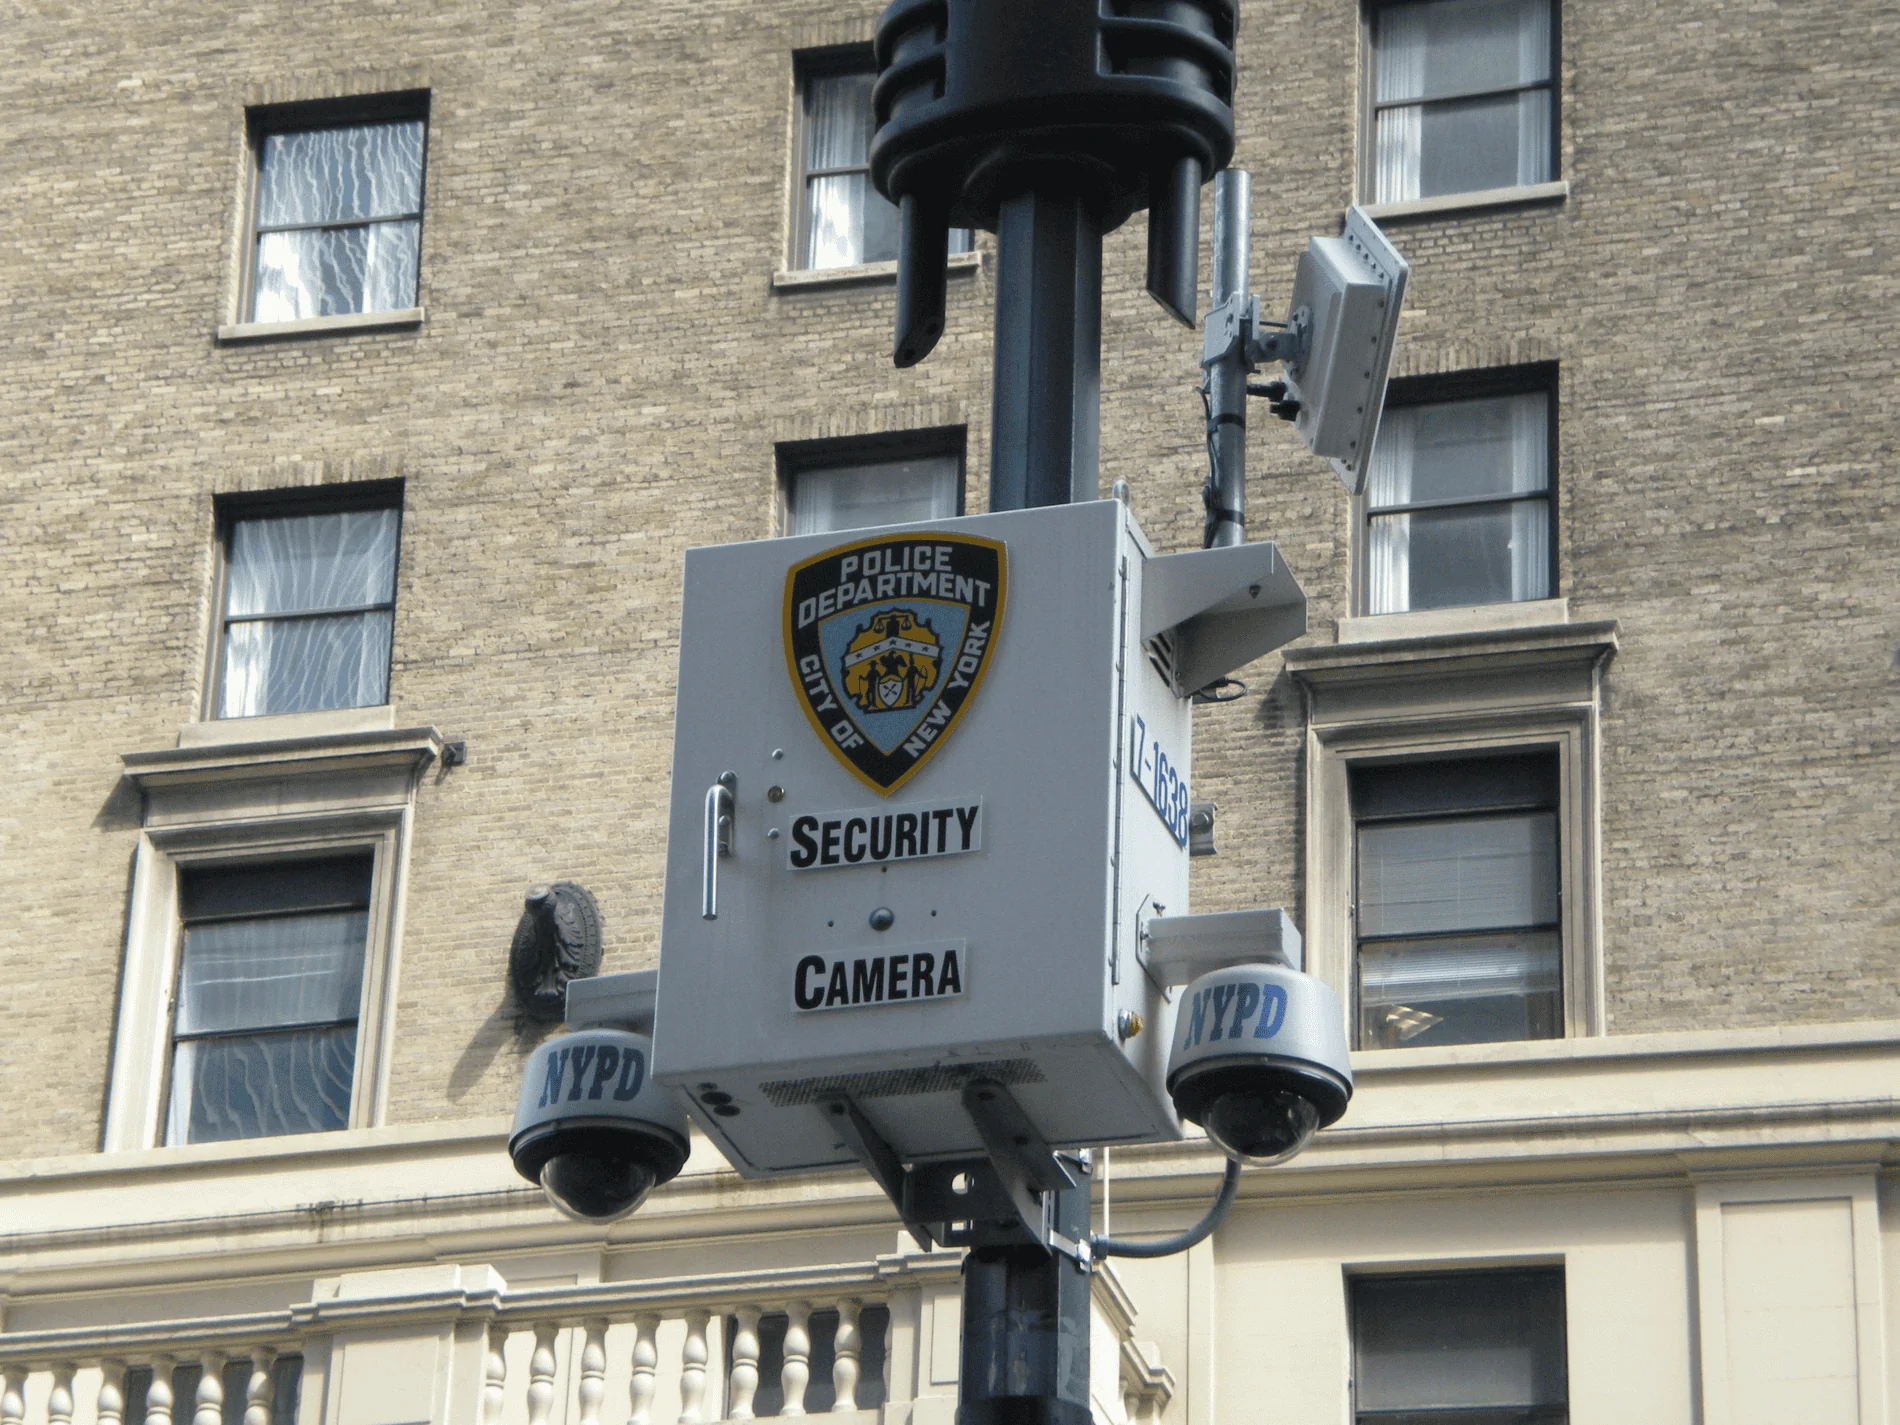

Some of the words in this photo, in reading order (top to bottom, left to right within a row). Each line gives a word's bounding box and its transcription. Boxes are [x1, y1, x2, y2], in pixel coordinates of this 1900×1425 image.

[841, 546, 953, 582] POLICE
[798, 571, 991, 629] DEPARTMENT
[799, 654, 839, 713] CITY
[830, 719, 864, 751] OF
[902, 698, 954, 759] NEW
[947, 619, 991, 690] YORK
[1136, 714, 1188, 847] 7-1638
[790, 805, 979, 868] SECURITY
[794, 950, 962, 1010] CAMERA
[1183, 982, 1288, 1050] NYPD
[537, 1045, 645, 1109] NYPD
